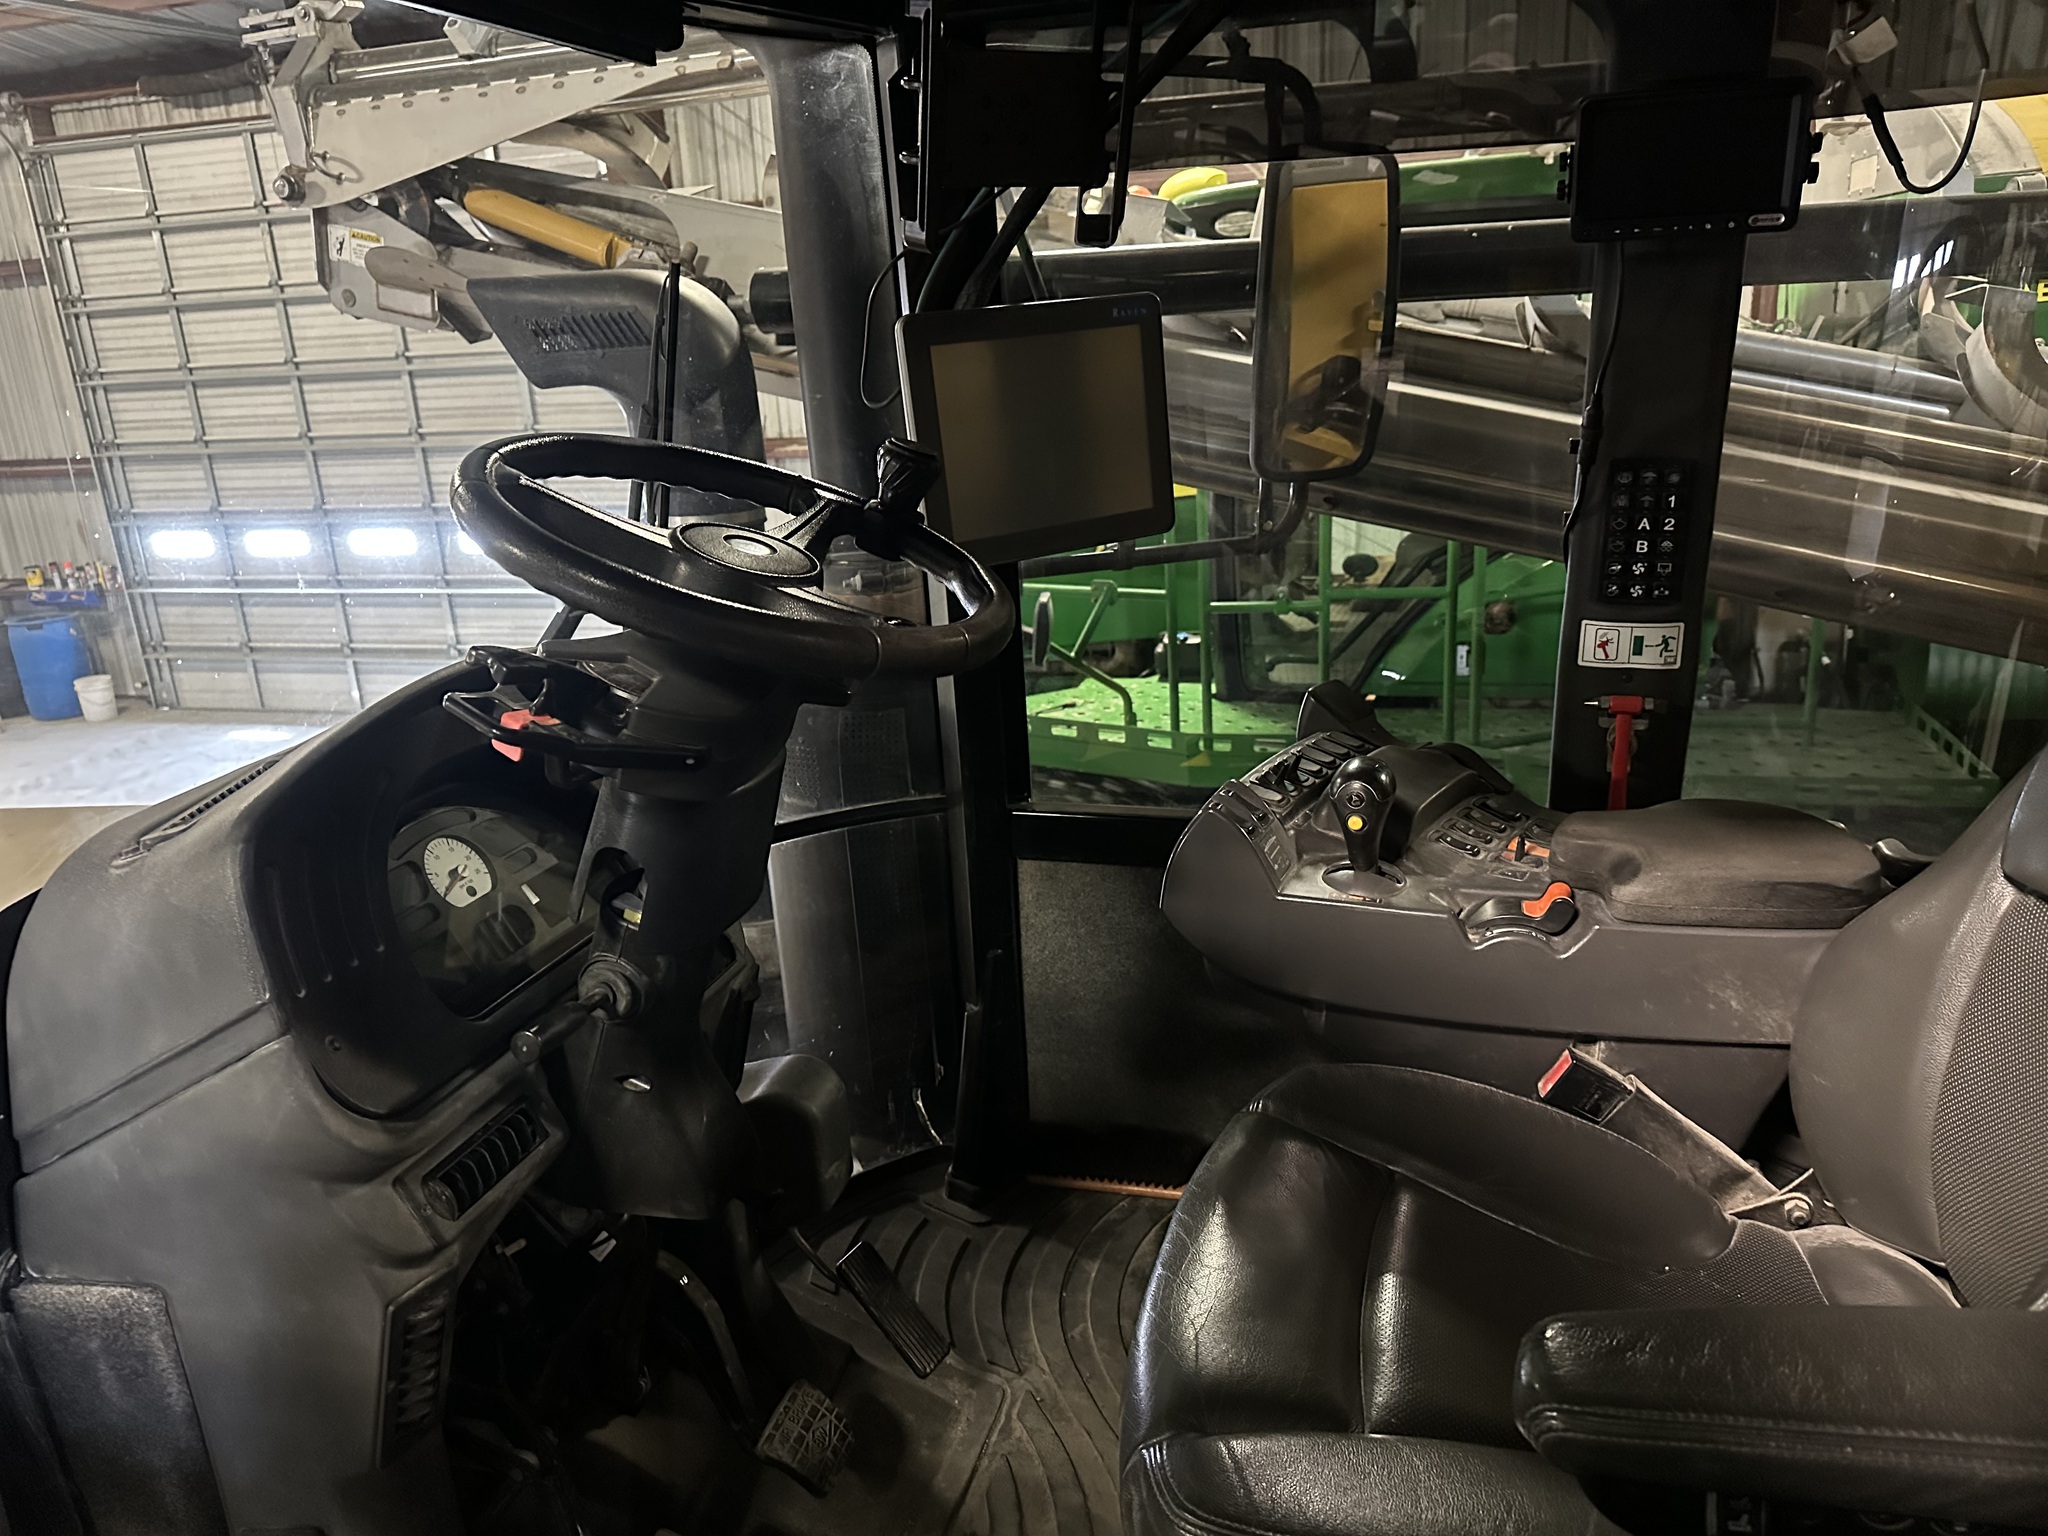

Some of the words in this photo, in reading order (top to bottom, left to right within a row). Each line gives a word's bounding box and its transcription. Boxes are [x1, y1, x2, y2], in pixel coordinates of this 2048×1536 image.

[1112, 307, 1147, 318] RAVEN
[1667, 495, 1676, 508] 1
[1637, 517, 1651, 531] A
[1663, 517, 1676, 531] 2
[1635, 540, 1649, 554] B
[787, 1392, 814, 1426] BRAKE
